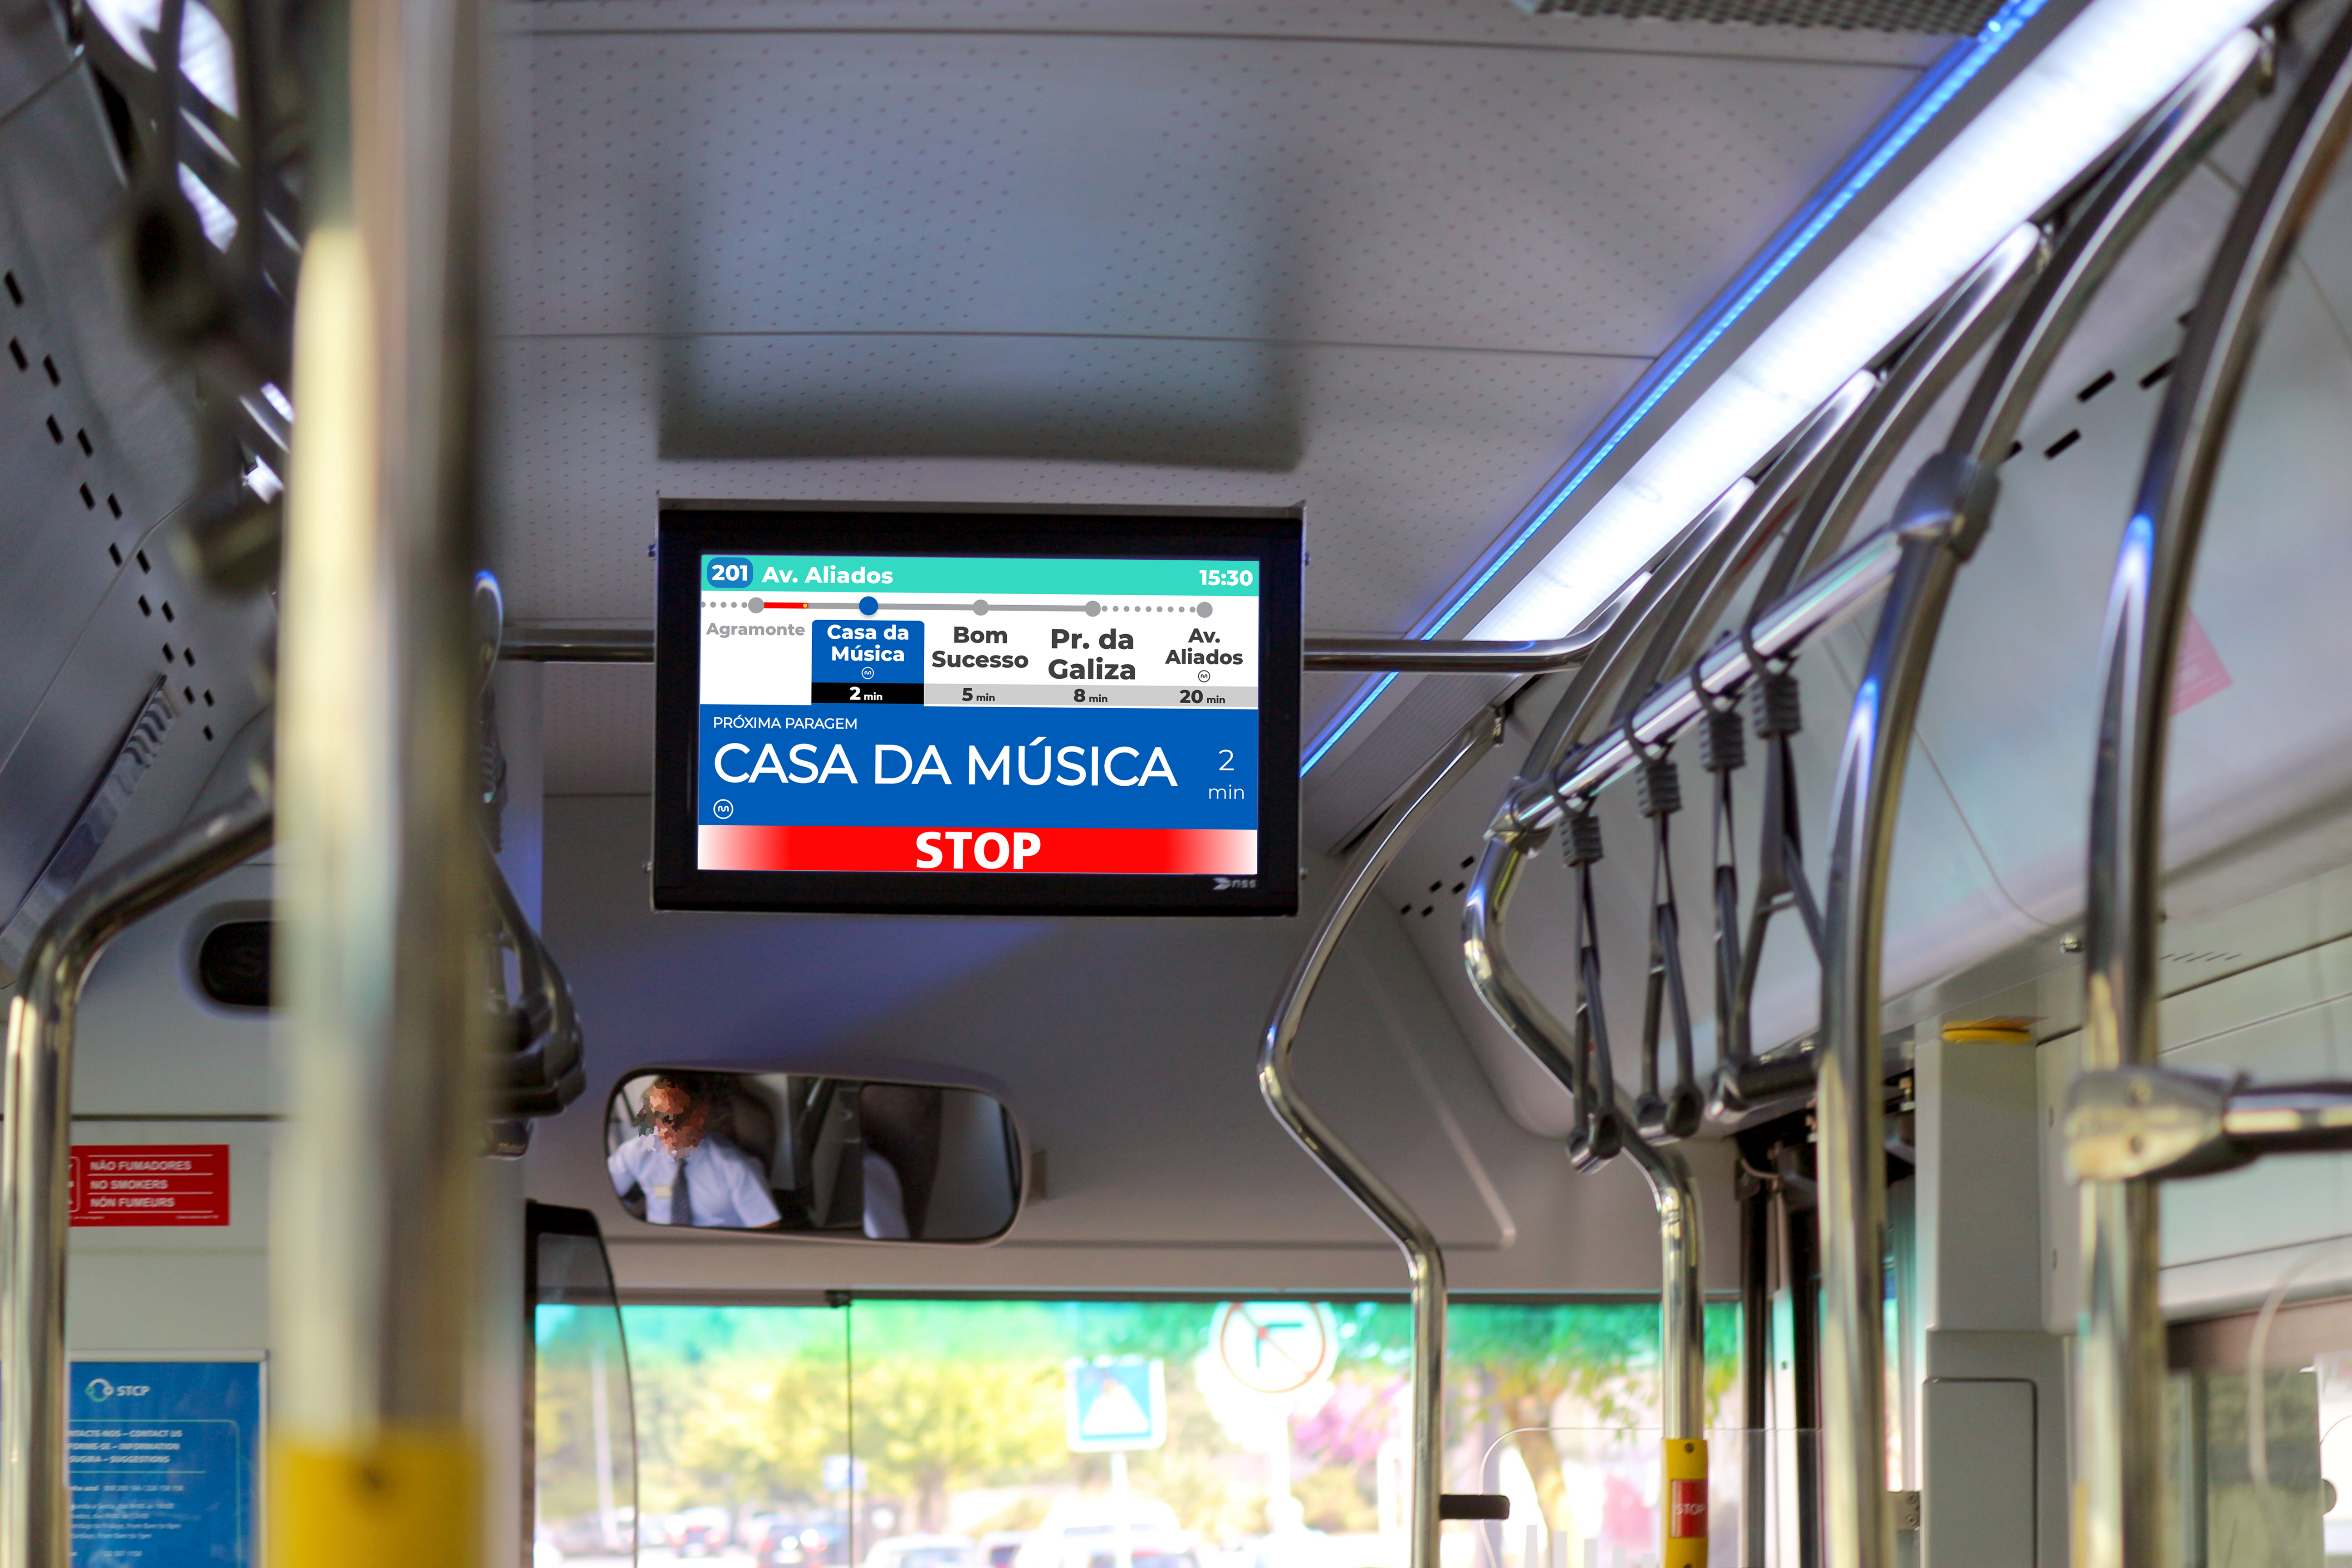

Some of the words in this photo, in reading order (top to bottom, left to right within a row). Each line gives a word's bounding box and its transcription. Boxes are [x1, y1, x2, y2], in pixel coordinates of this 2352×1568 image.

[712, 564, 748, 581] 201
[762, 567, 798, 583] Av.
[805, 565, 893, 584] Aliados
[1199, 570, 1253, 586] 15:30
[706, 623, 805, 638] Agramonte
[827, 624, 877, 640] Casa
[883, 624, 909, 640] da
[954, 626, 1007, 644] Bom
[1188, 628, 1220, 643] Av.
[1052, 629, 1090, 649] Pr.
[1099, 628, 1134, 650] da
[832, 644, 905, 662] Música
[932, 650, 1029, 668] Sucesso
[1165, 647, 1243, 665] Aliados
[1048, 657, 1136, 680] Galiza
[849, 686, 861, 701] 2
[864, 691, 882, 701] min
[962, 687, 973, 701] 5
[976, 693, 995, 701] min
[1073, 688, 1086, 703] 8
[1089, 694, 1108, 703] min
[1180, 689, 1203, 704] 20
[1206, 695, 1225, 704] min
[714, 715, 782, 729] PRÓXIMA
[785, 717, 857, 730] PARAGEM
[714, 743, 858, 784] CASA
[875, 744, 952, 785] DA
[969, 736, 1178, 787] MÚSICA
[1219, 749, 1234, 771] 2
[1209, 784, 1244, 799] min
[916, 831, 1041, 870] STOP
[90, 1160, 117, 1171] NÃO
[118, 1161, 191, 1171] FUMADORES
[90, 1180, 108, 1190] NO
[110, 1180, 168, 1190] SMOKERS
[118, 1197, 176, 1208] FUMEURS
[117, 1386, 150, 1396] STCP
[1676, 1503, 1706, 1515] STOP
